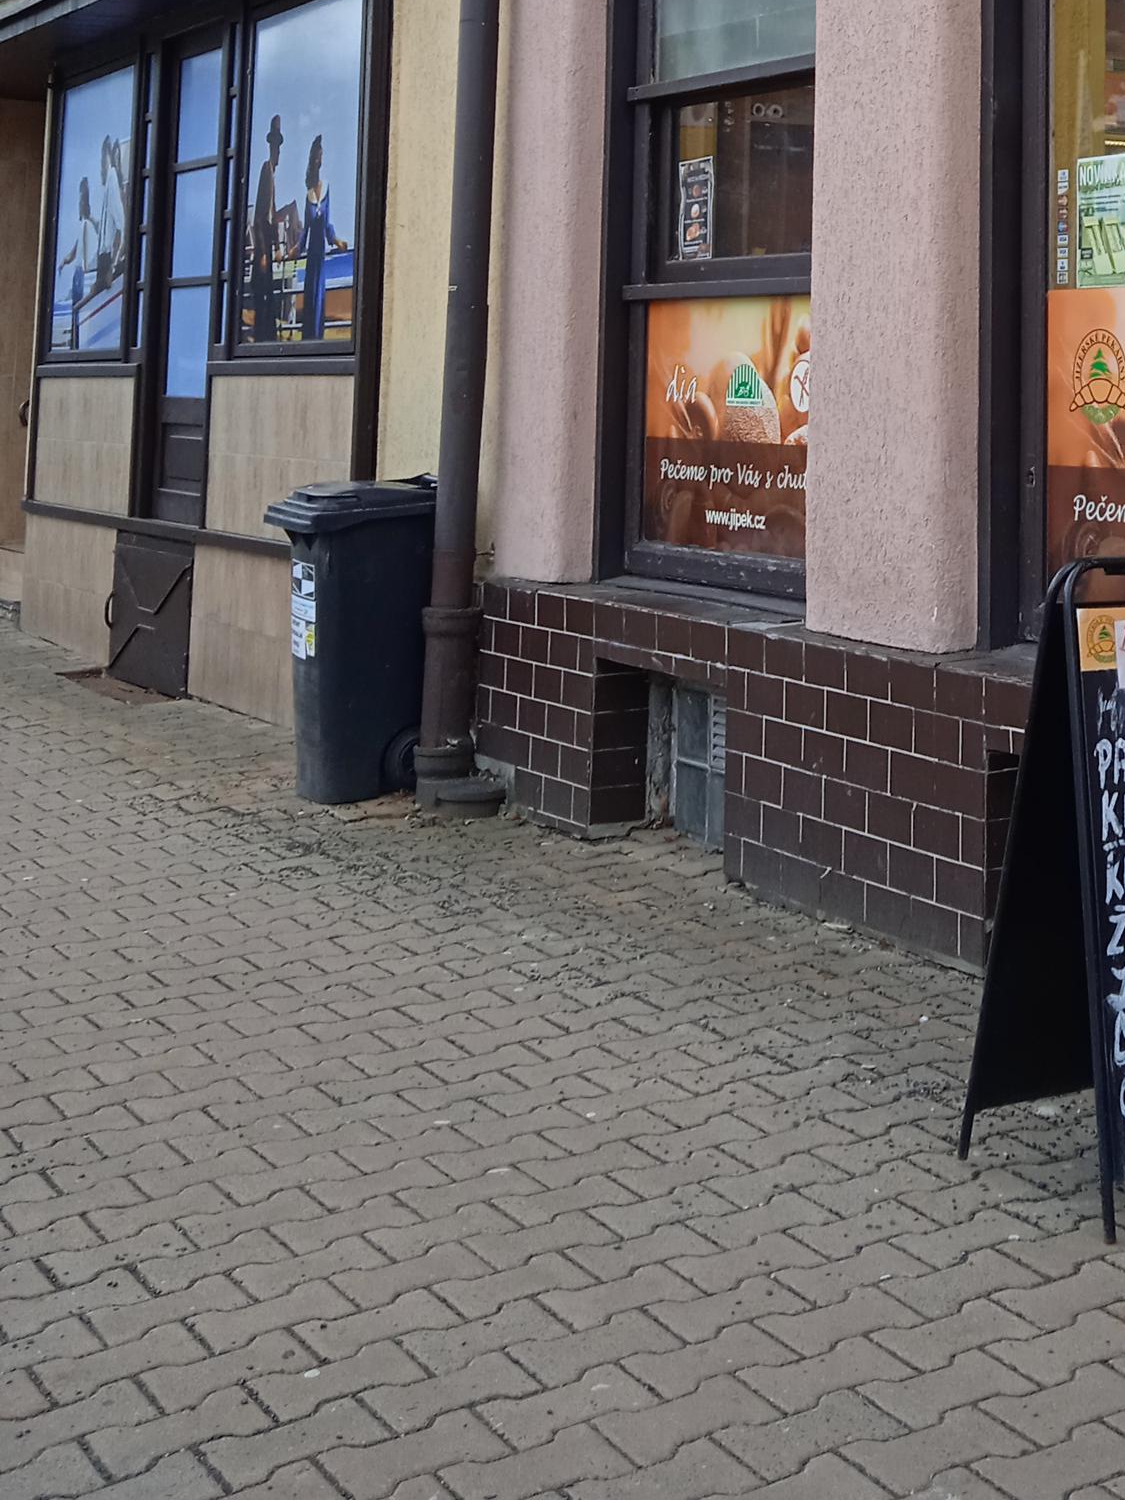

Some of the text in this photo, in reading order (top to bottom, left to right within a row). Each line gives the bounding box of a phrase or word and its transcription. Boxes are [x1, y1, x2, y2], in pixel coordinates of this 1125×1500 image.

[666, 364, 698, 403] dia
[660, 458, 707, 481] Pečeme
[709, 464, 734, 490] pro
[736, 462, 763, 488] Vás
[765, 474, 773, 489] s
[705, 508, 766, 531] www.jipek.cz
